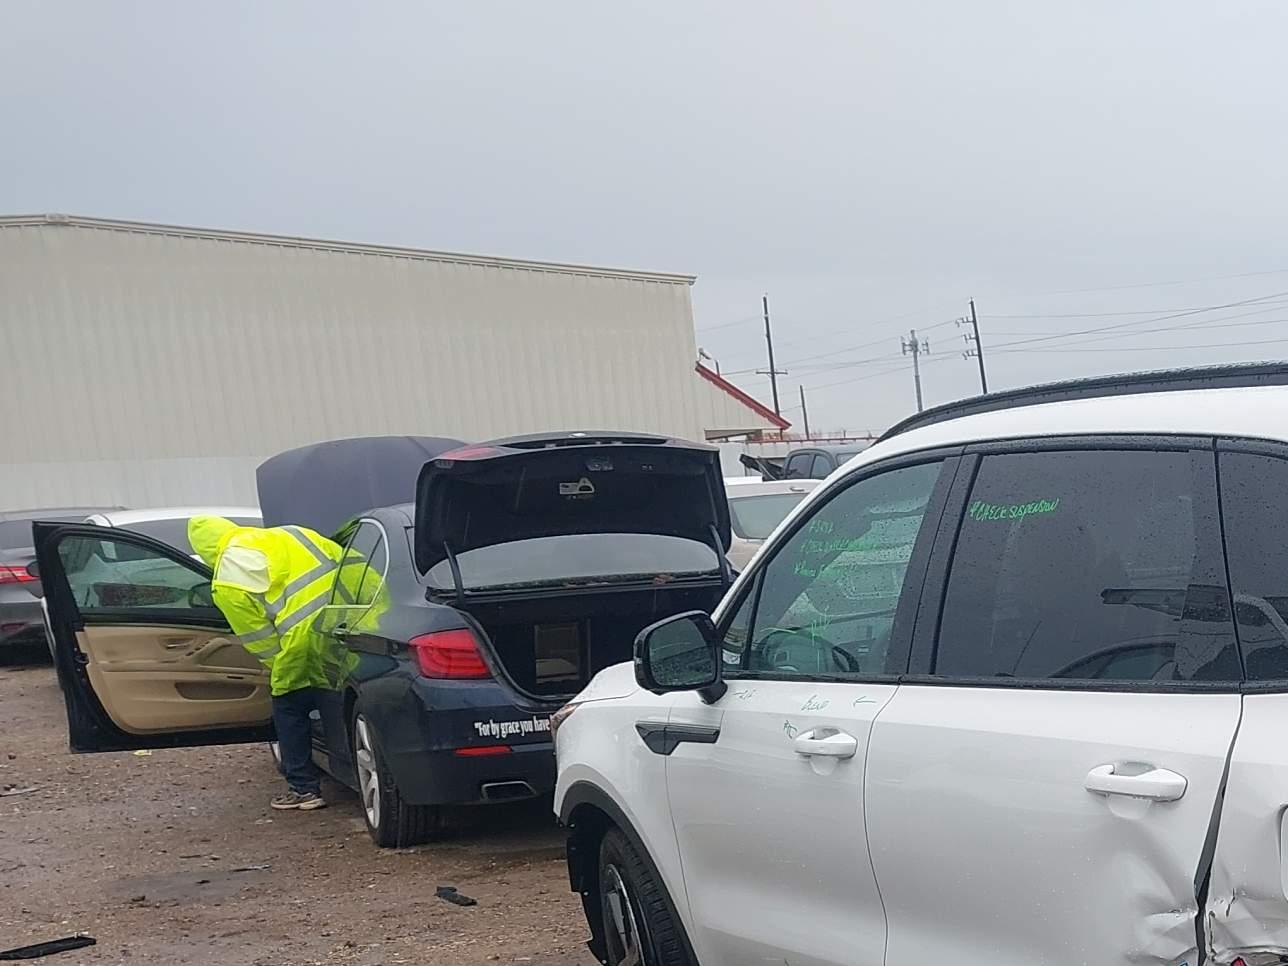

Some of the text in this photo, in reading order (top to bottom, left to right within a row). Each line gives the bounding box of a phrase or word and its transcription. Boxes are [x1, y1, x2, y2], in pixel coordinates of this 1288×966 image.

[490, 719, 500, 739] by
[500, 721, 520, 738] grace
[520, 720, 533, 737] you
[533, 715, 550, 732] have
